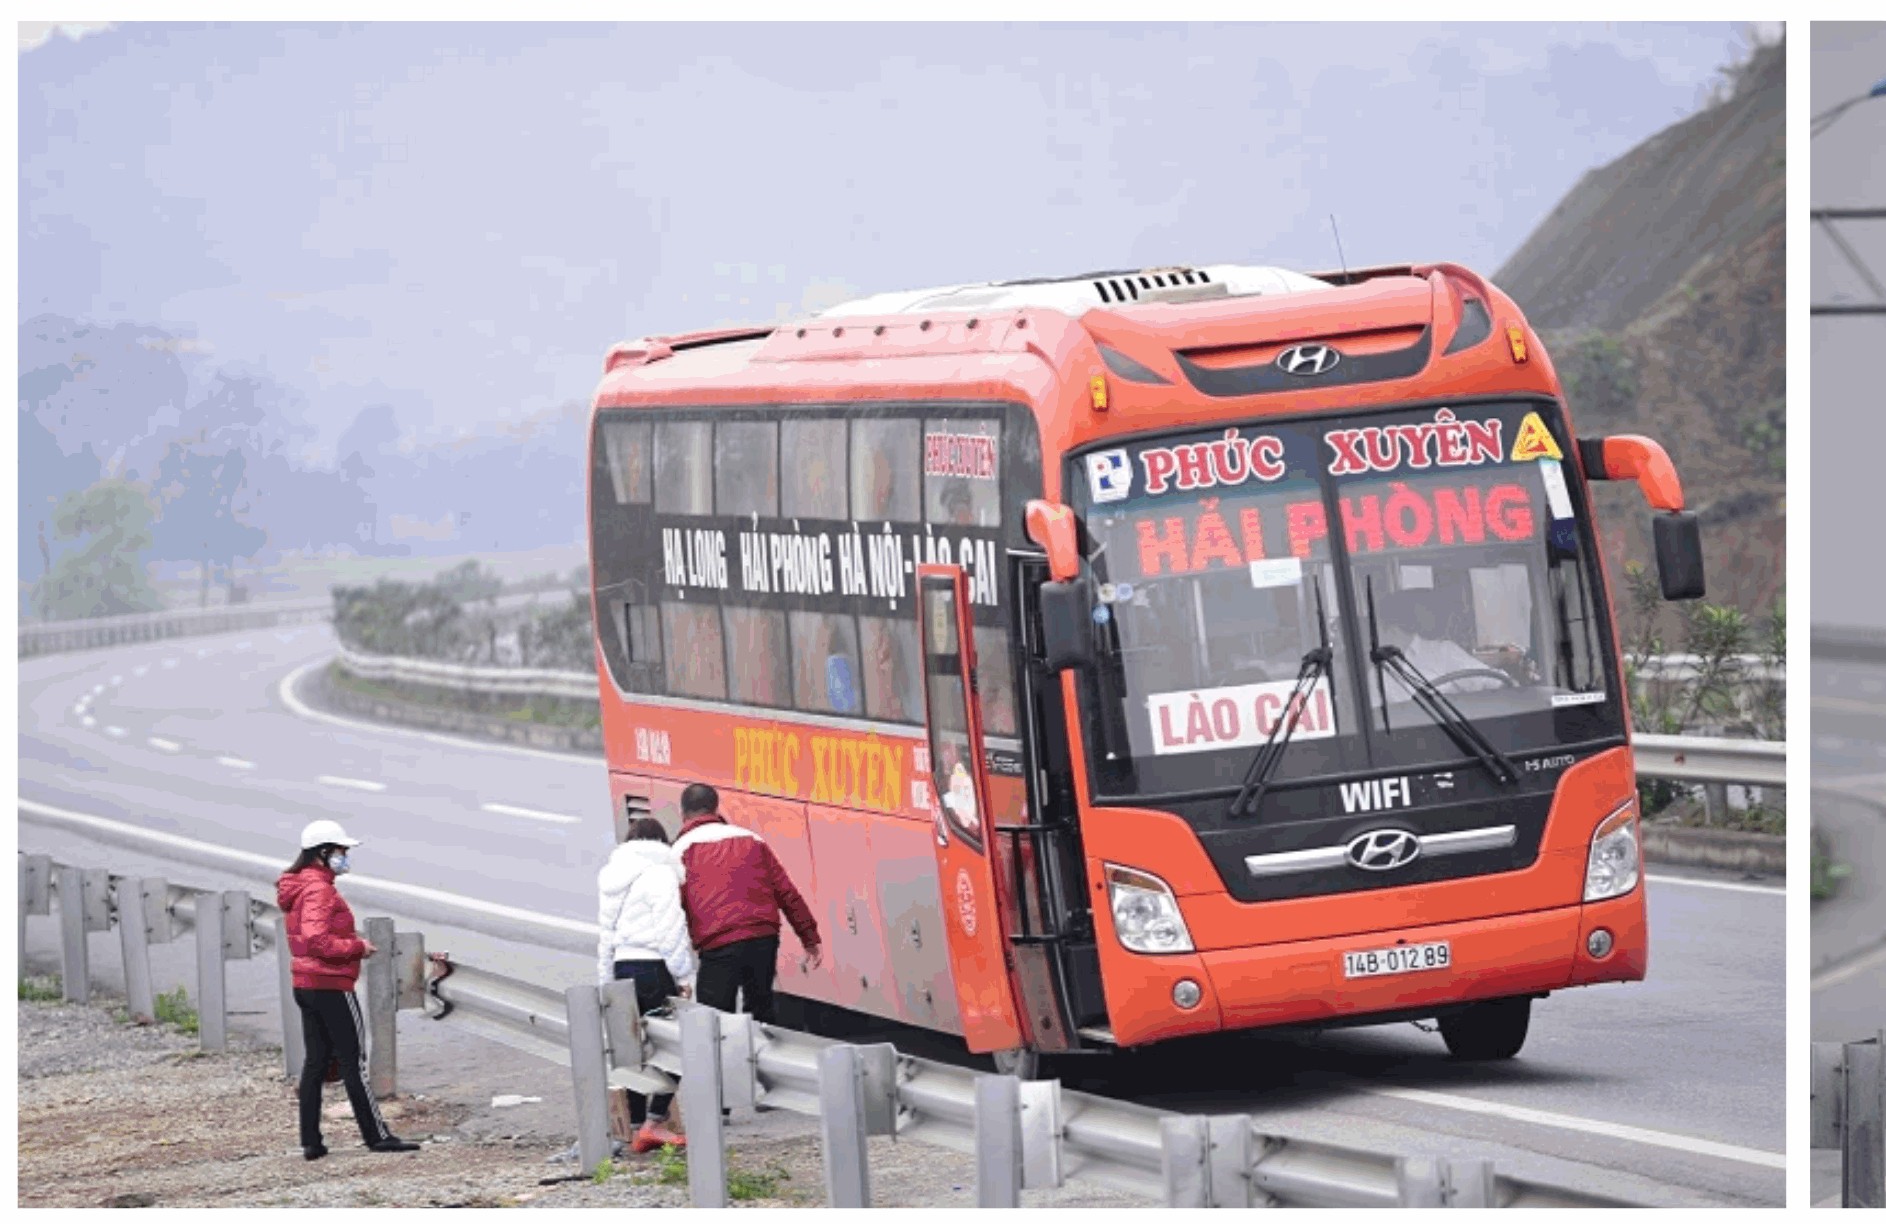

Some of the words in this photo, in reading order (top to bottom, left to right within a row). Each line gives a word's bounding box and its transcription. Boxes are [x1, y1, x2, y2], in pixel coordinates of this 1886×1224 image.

[1140, 429, 1286, 495] PHÚC
[1324, 408, 1502, 475] XUYÊN
[1286, 480, 1535, 559] PHÒNG
[686, 529, 728, 589] LONG
[770, 518, 833, 595] PHÒNG
[838, 521, 868, 596] HÀ
[1159, 692, 1241, 747] LÀO
[1255, 689, 1330, 736] CAI
[1340, 777, 1412, 813] WIFI
[1543, 754, 1575, 769] AUTO
